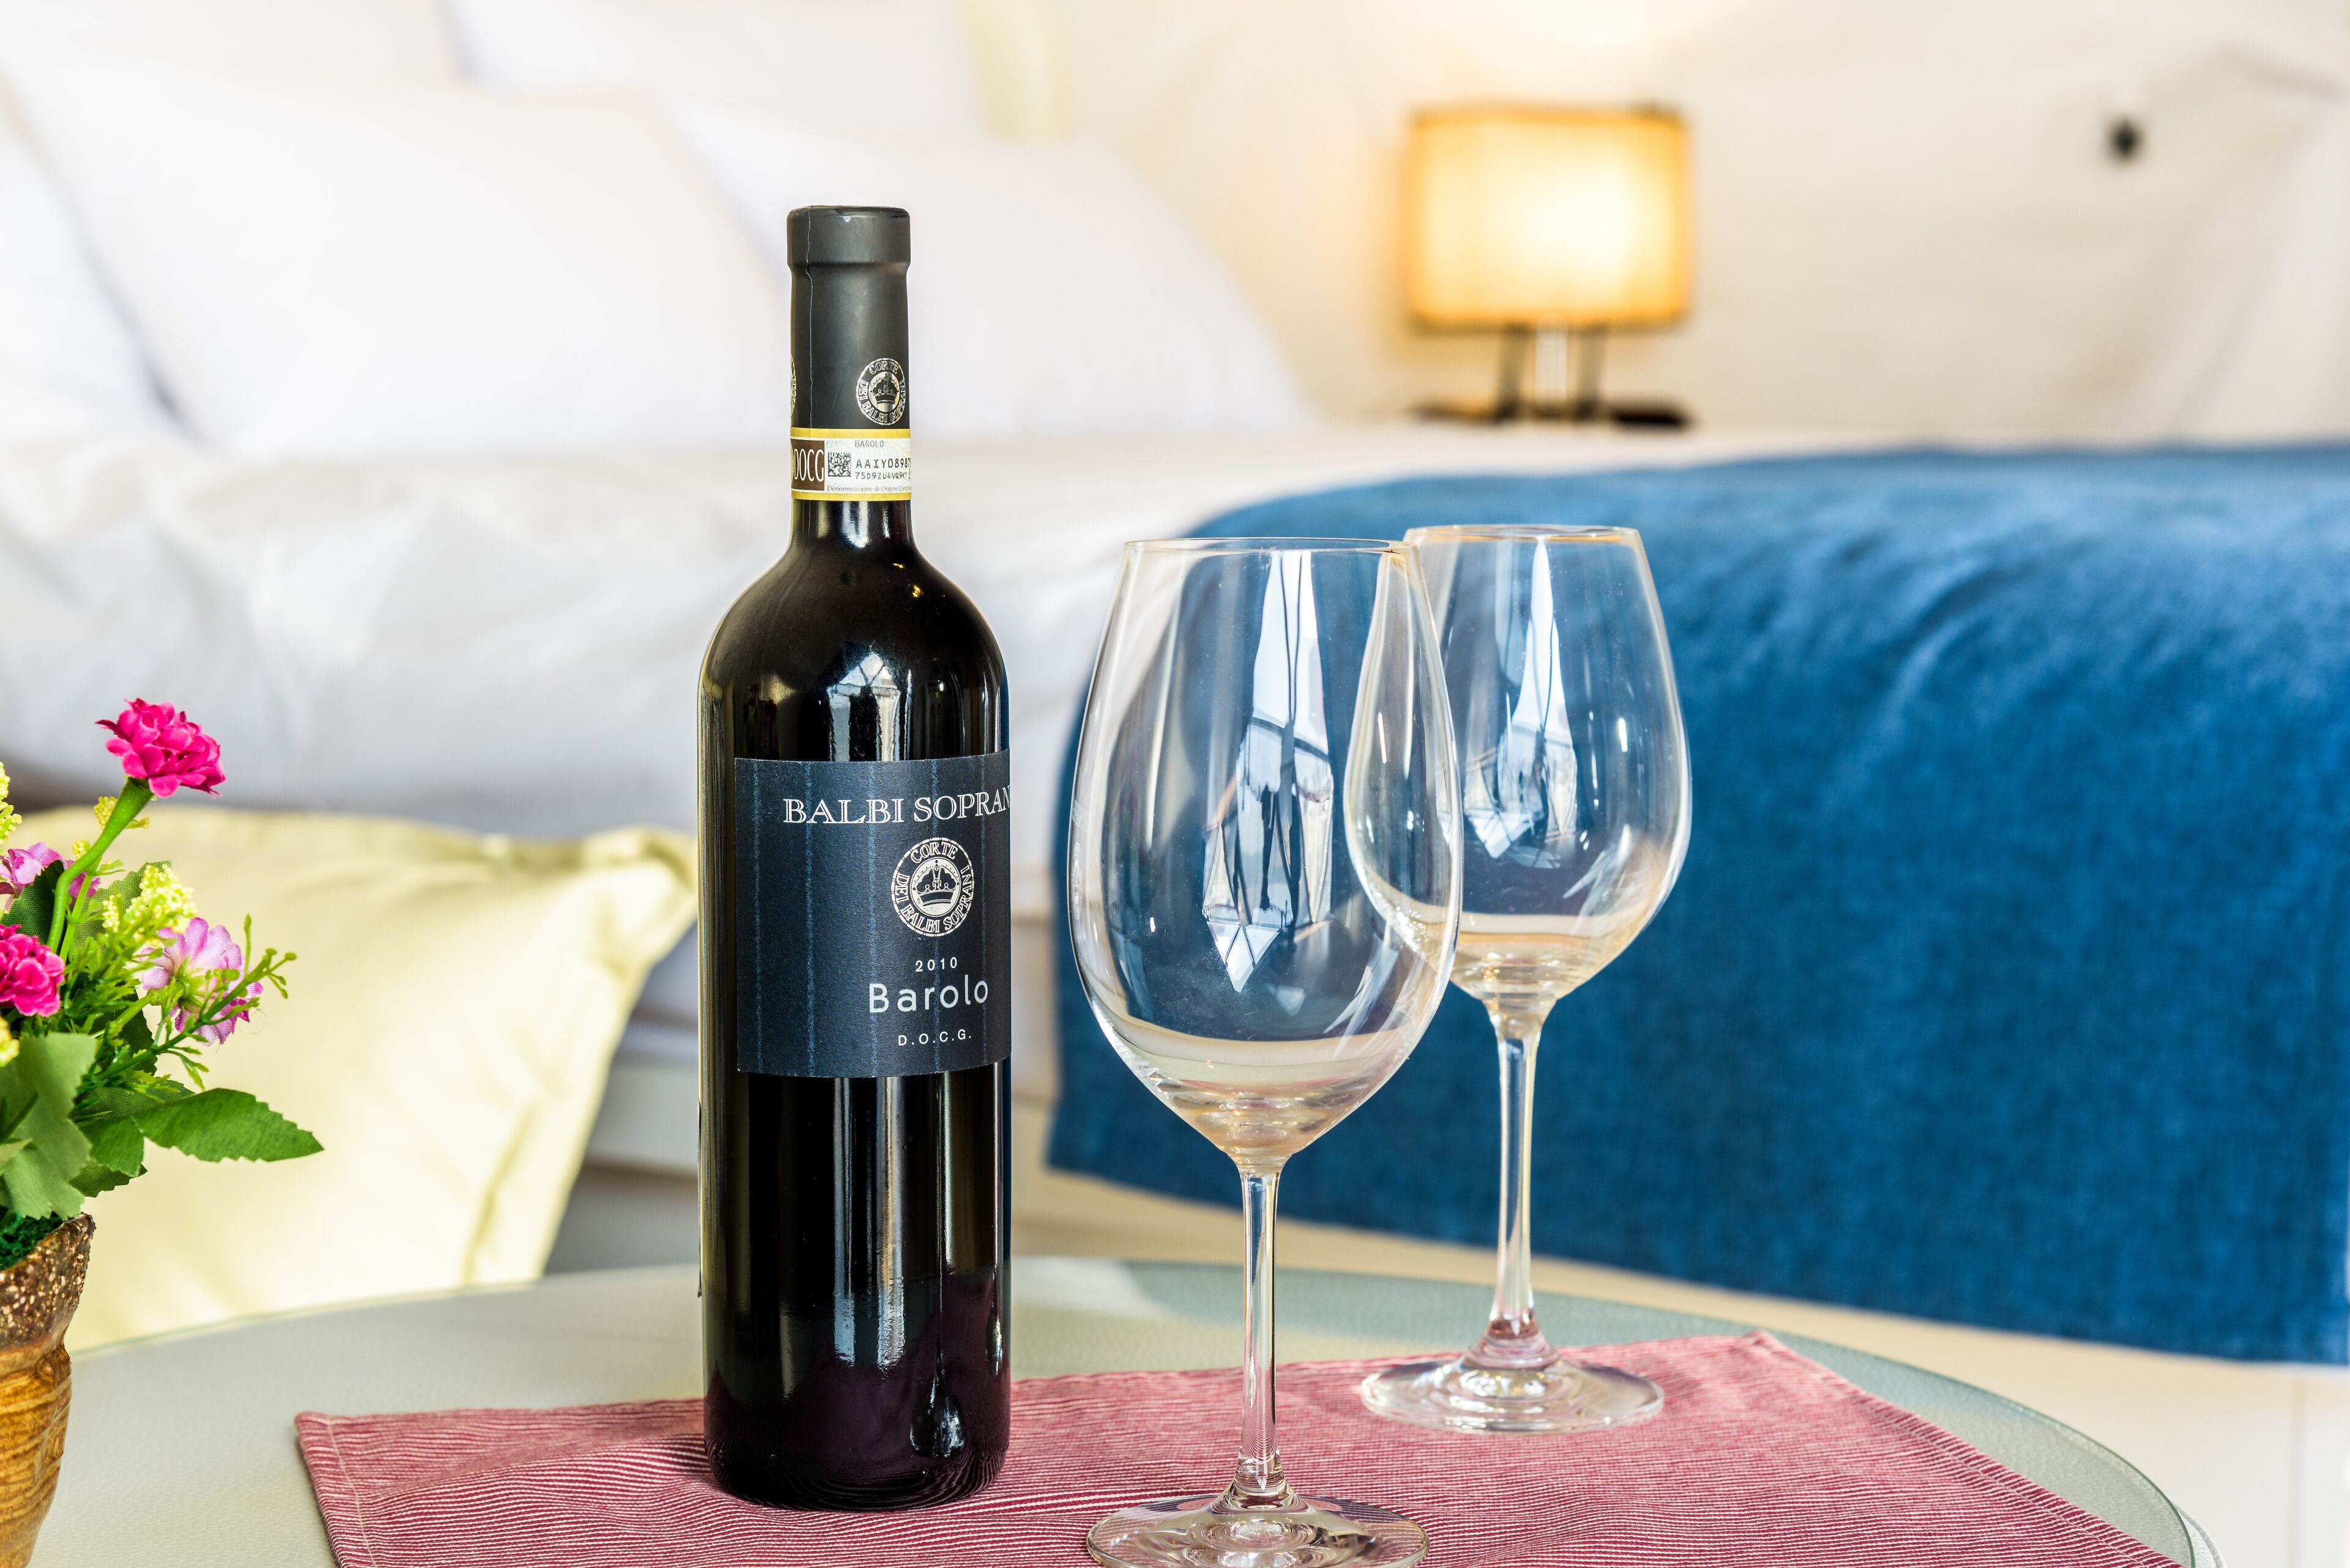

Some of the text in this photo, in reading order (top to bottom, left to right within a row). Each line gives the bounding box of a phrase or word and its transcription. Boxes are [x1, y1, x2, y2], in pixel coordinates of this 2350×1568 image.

[869, 360, 899, 375] CORTE
[859, 379, 869, 400] DEI
[862, 401, 888, 423] BALBI
[794, 448, 824, 482] DOCG
[783, 798, 905, 824] BALBI
[911, 842, 958, 864] CORTE
[895, 865, 972, 933] DEI BALBI SOPRANI
[915, 957, 958, 972] 2010
[869, 974, 988, 1014] Barolo
[898, 1029, 972, 1046] D.O.C.G.
